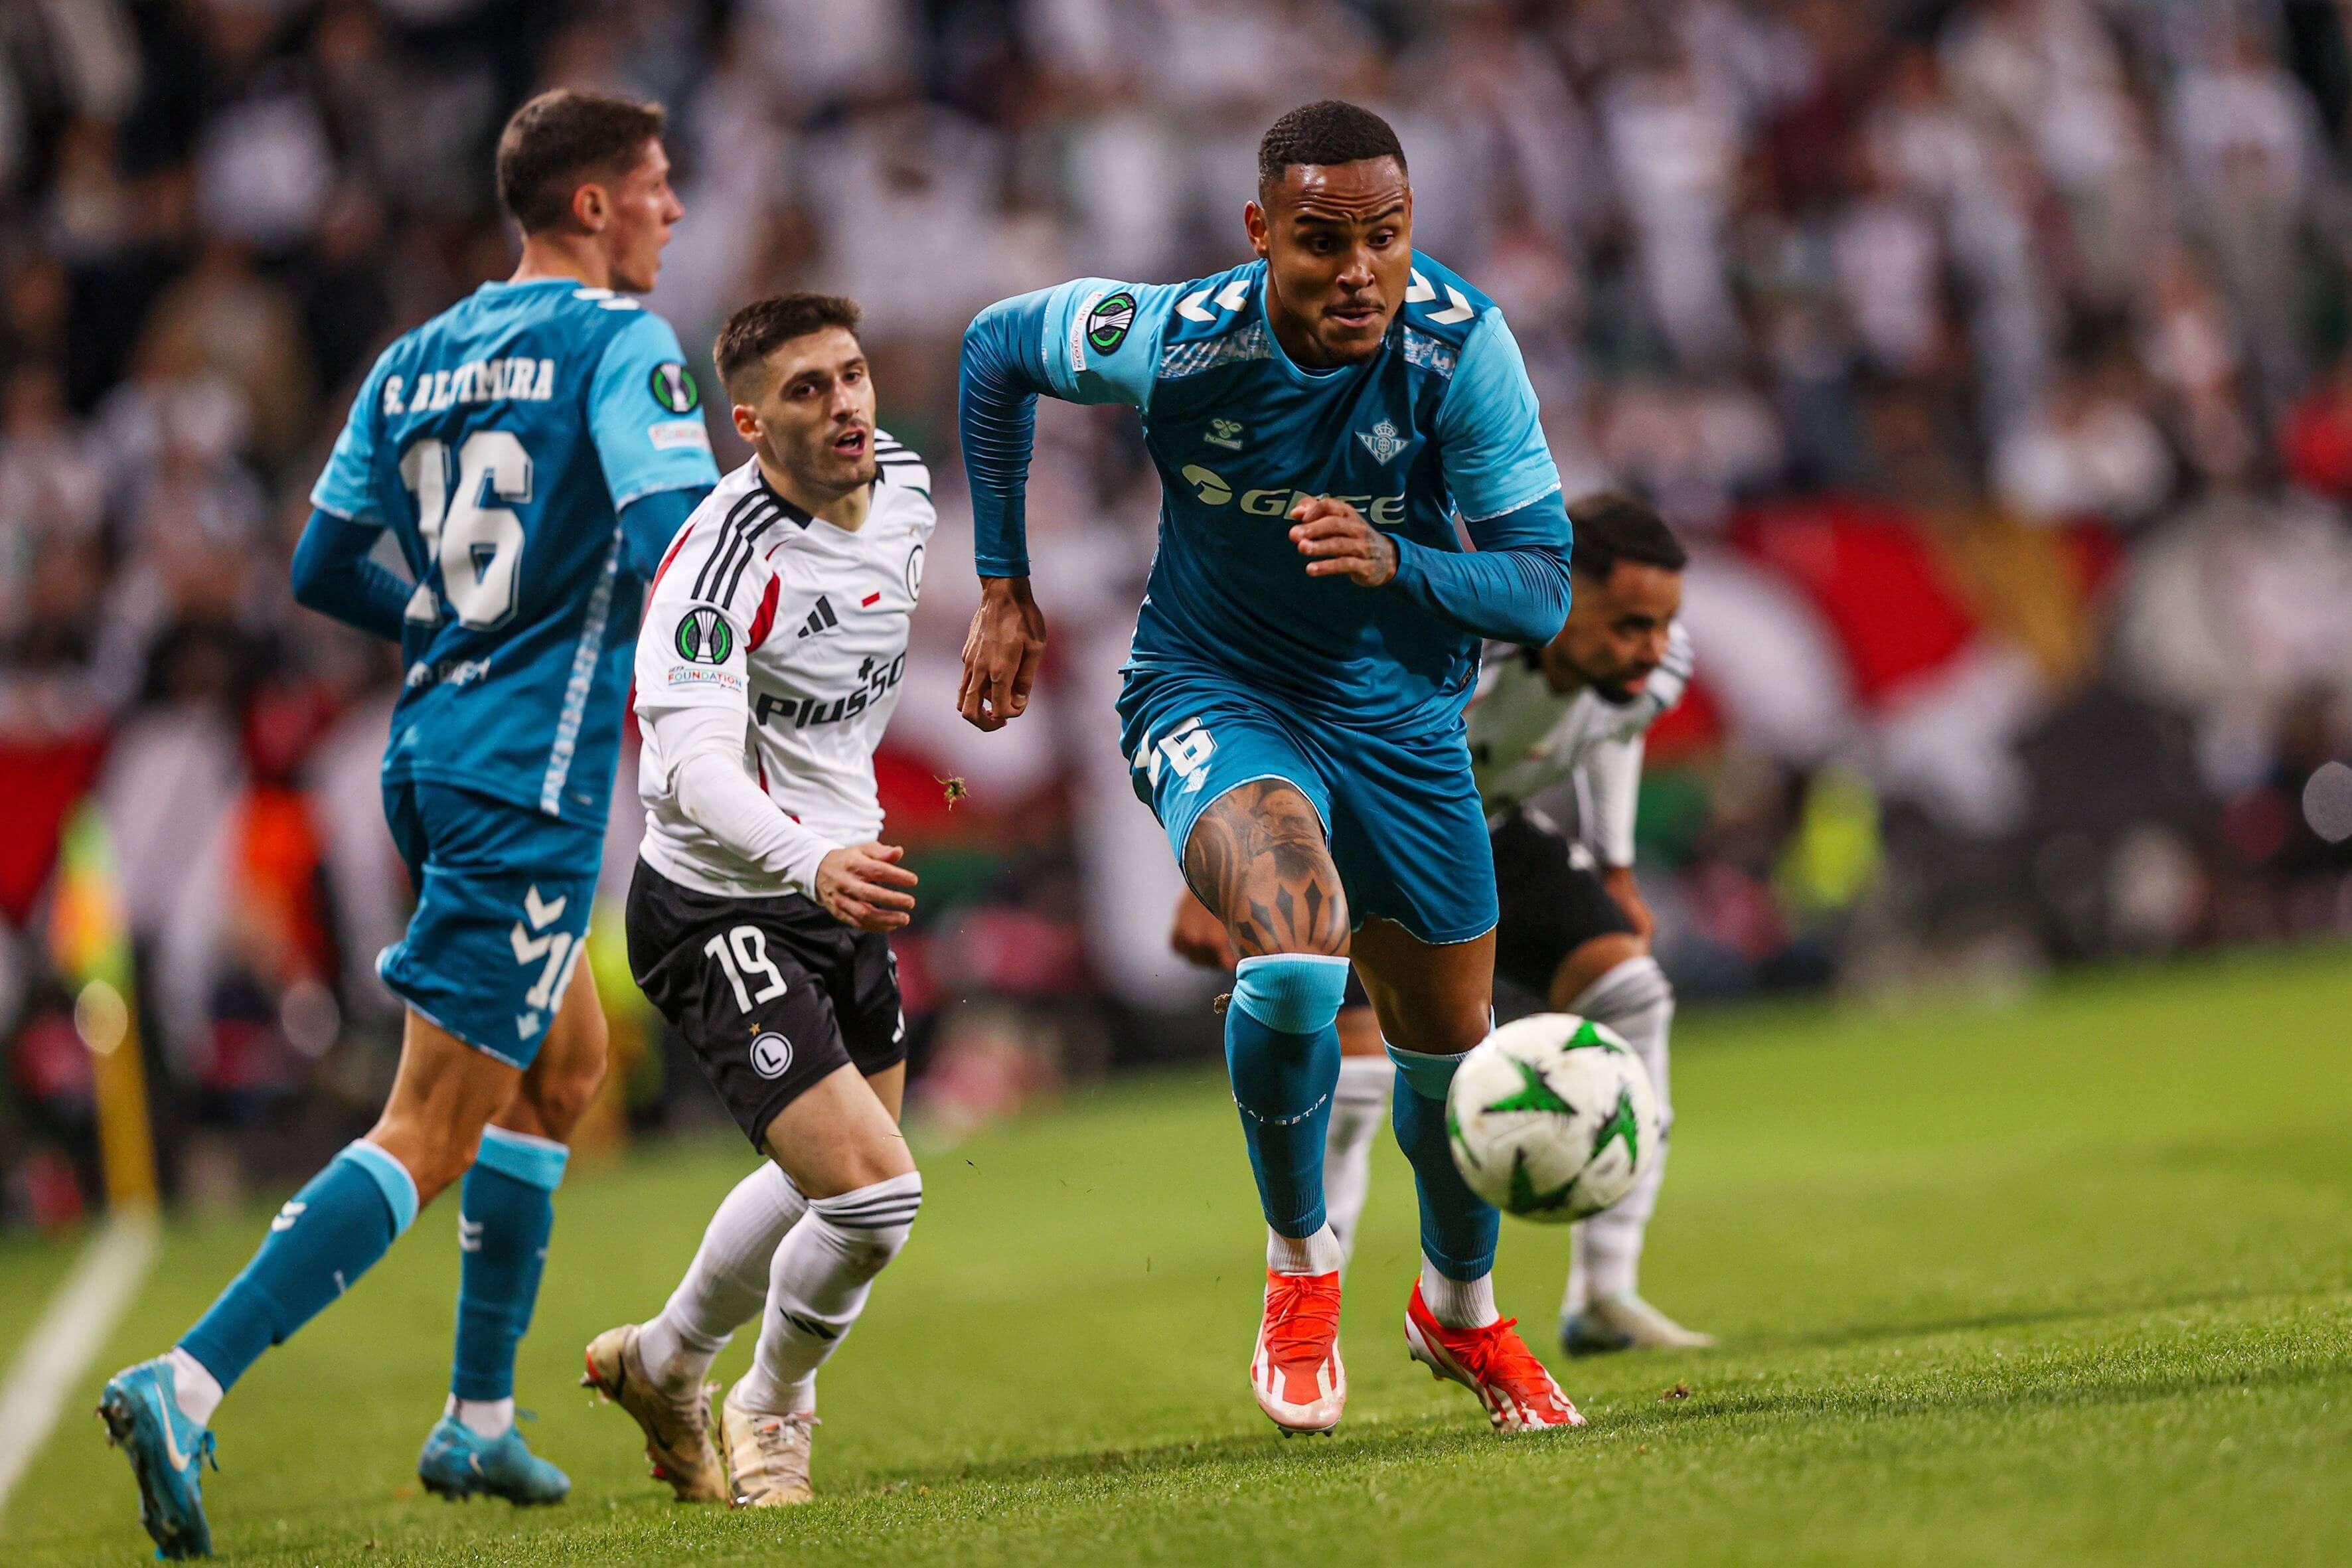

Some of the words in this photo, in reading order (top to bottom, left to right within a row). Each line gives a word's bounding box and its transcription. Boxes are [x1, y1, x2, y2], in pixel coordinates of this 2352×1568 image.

[400, 431, 534, 631] 16
[668, 671, 742, 688] FOUNDATION
[704, 925, 788, 1014] 19
[760, 1048, 781, 1067] L
